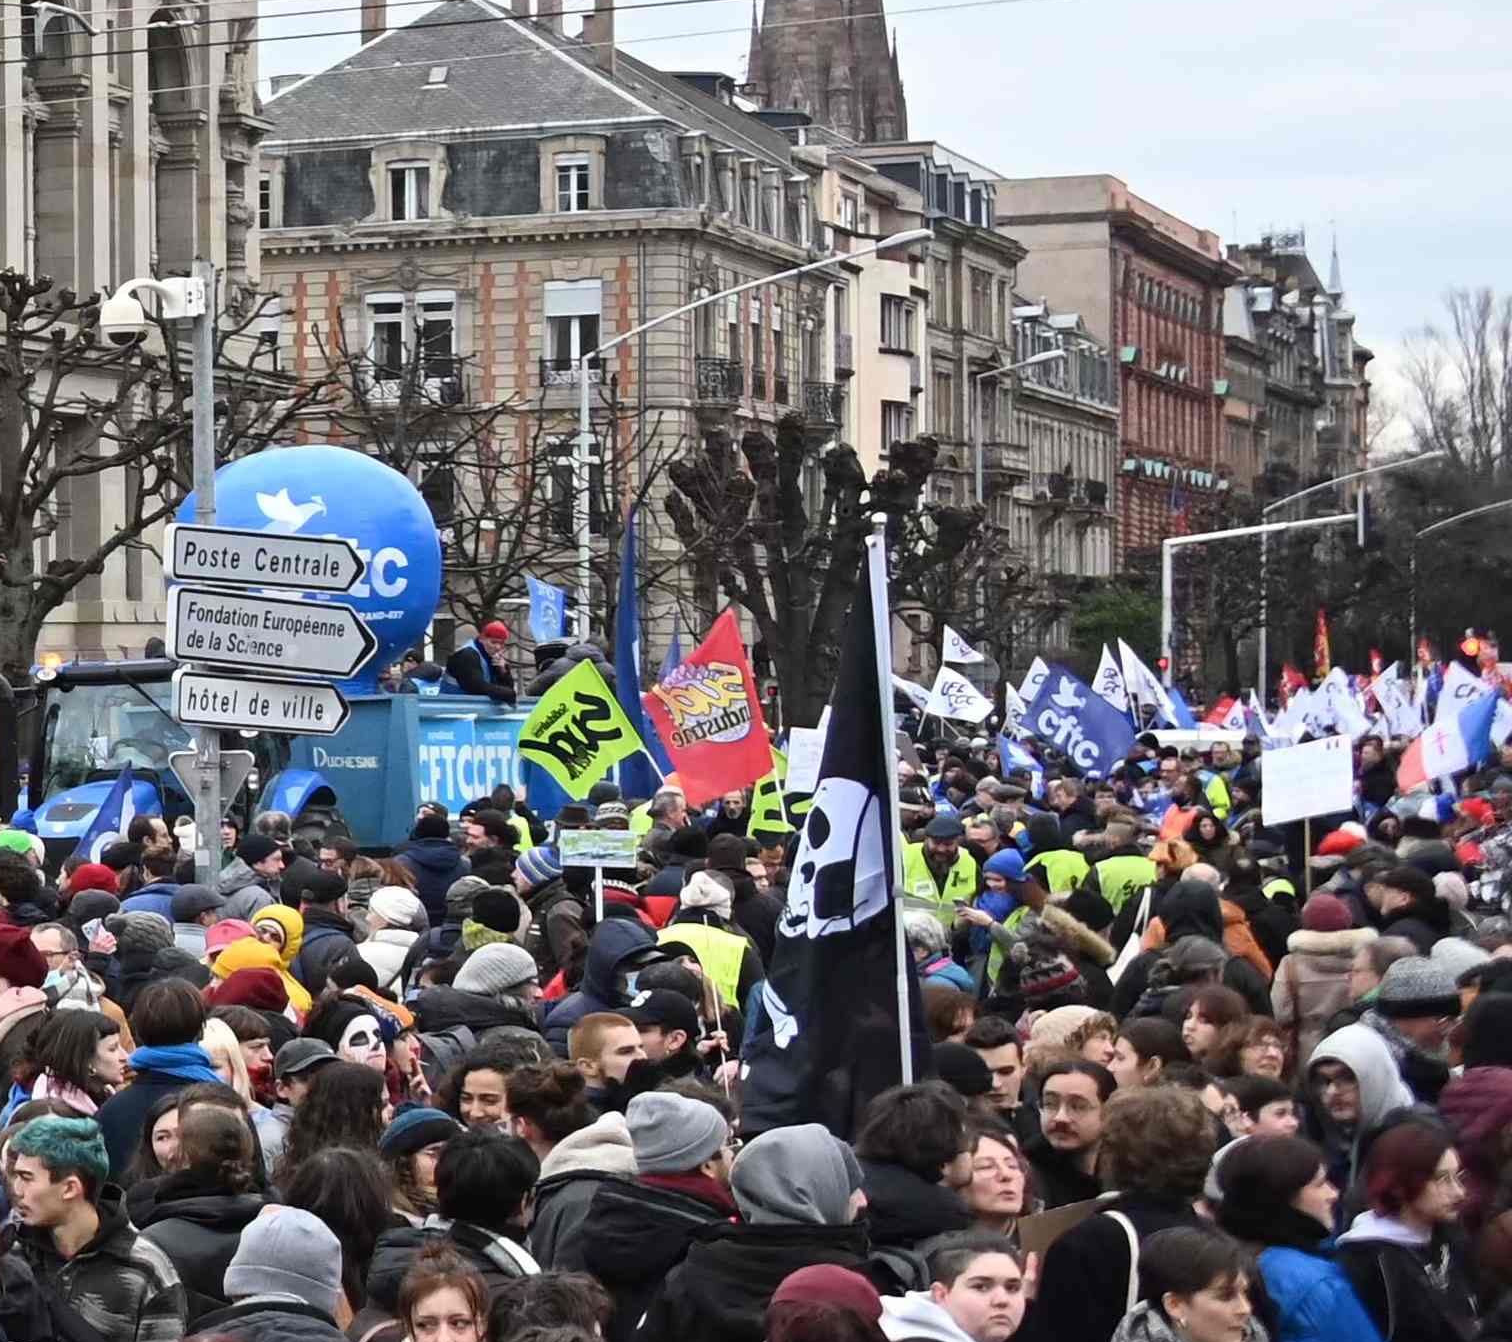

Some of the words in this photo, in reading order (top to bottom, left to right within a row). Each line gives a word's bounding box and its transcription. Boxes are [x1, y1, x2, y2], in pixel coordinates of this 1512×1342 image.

[183, 541, 241, 570] Poste
[254, 547, 341, 578] Centrale
[187, 601, 258, 629] Fondation
[262, 610, 346, 638] Européenne
[186, 629, 204, 649] de
[208, 631, 222, 651] la
[226, 633, 284, 658] Science
[187, 686, 239, 715] hôtel
[248, 692, 270, 717] de
[282, 694, 325, 722] ville
[1037, 708, 1100, 768] cftc
